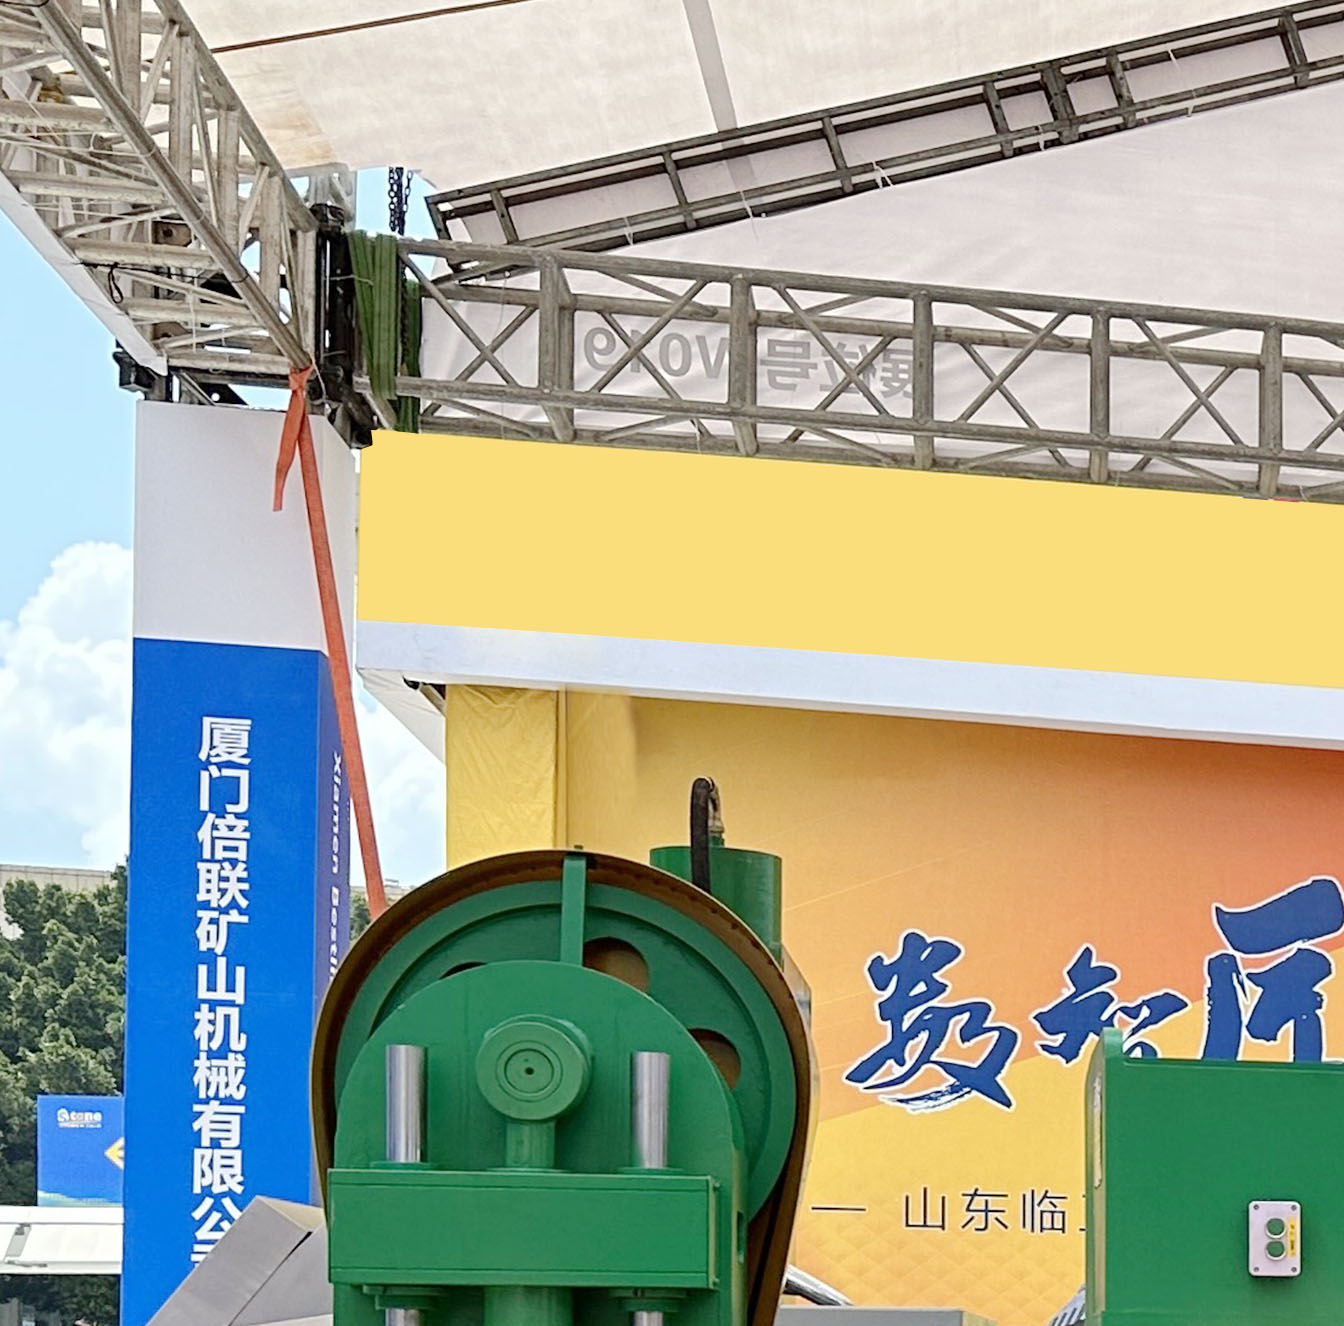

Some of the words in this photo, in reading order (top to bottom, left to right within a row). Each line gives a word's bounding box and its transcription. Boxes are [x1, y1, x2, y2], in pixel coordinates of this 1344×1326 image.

[190, 716, 252, 1266] 厦门倍联矿山机械有限公
[905, 1187, 1086, 1235] 山东临
